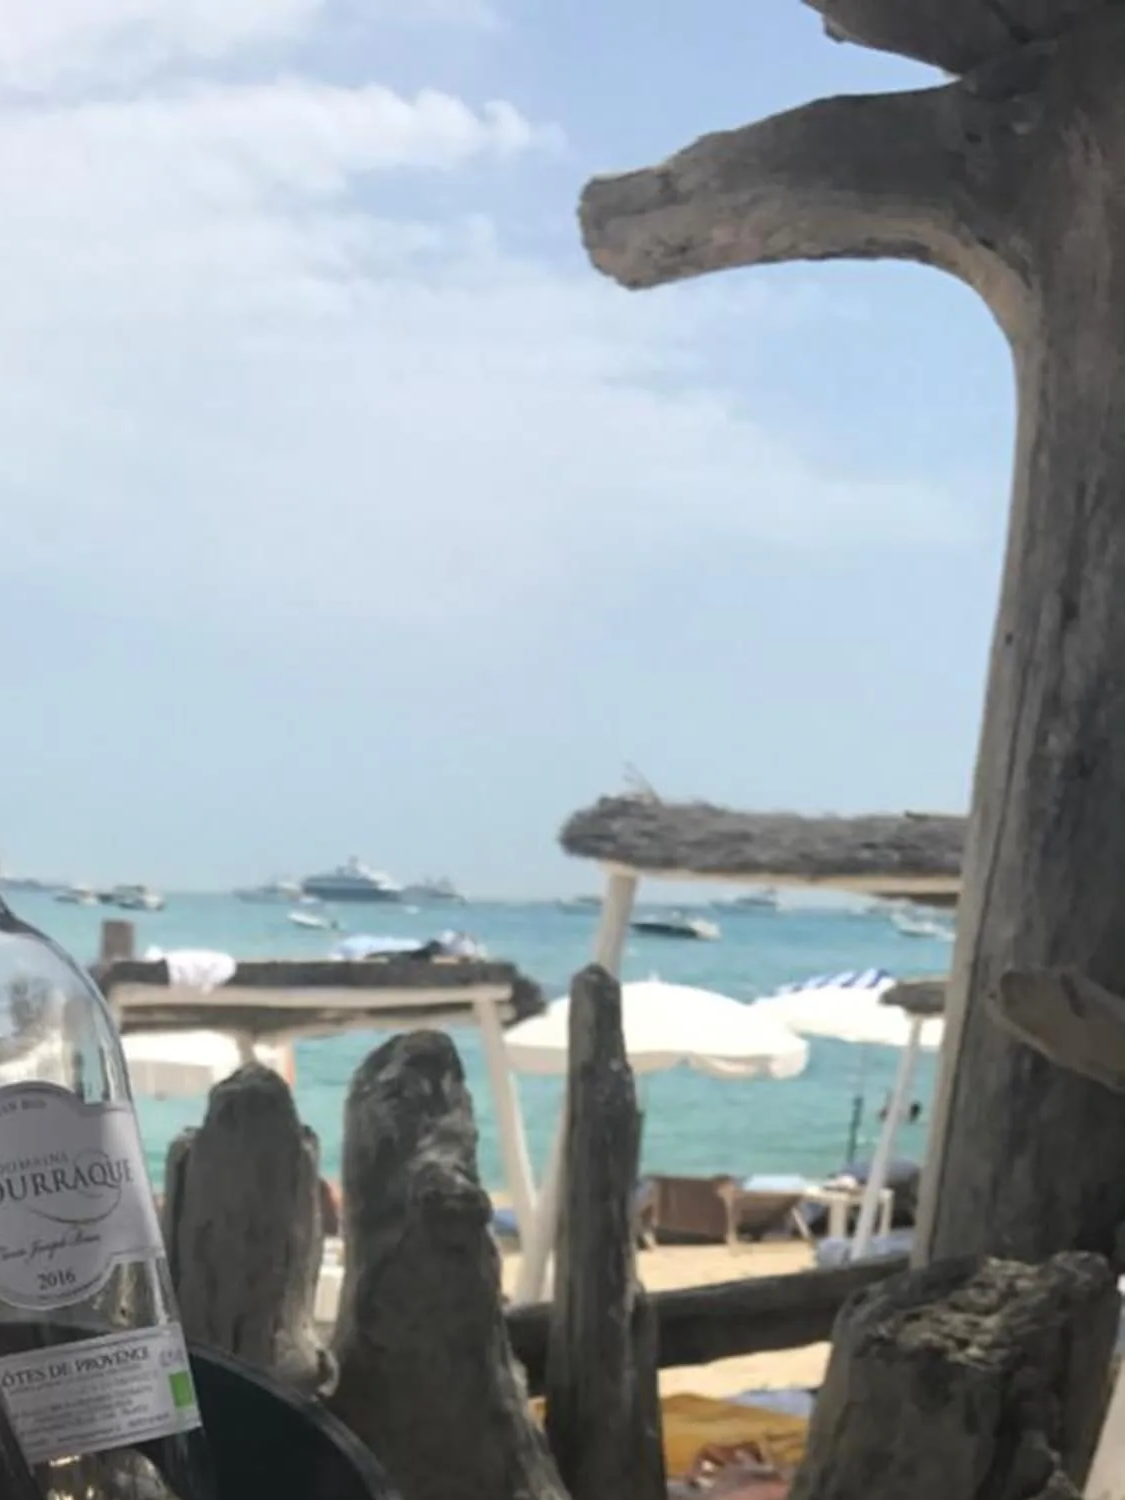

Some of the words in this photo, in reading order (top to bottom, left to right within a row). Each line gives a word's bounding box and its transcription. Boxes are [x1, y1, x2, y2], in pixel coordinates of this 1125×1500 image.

[37, 1268, 77, 1290] 2016
[48, 1362, 70, 1380] DE
[75, 1346, 150, 1372] PROVENCE
